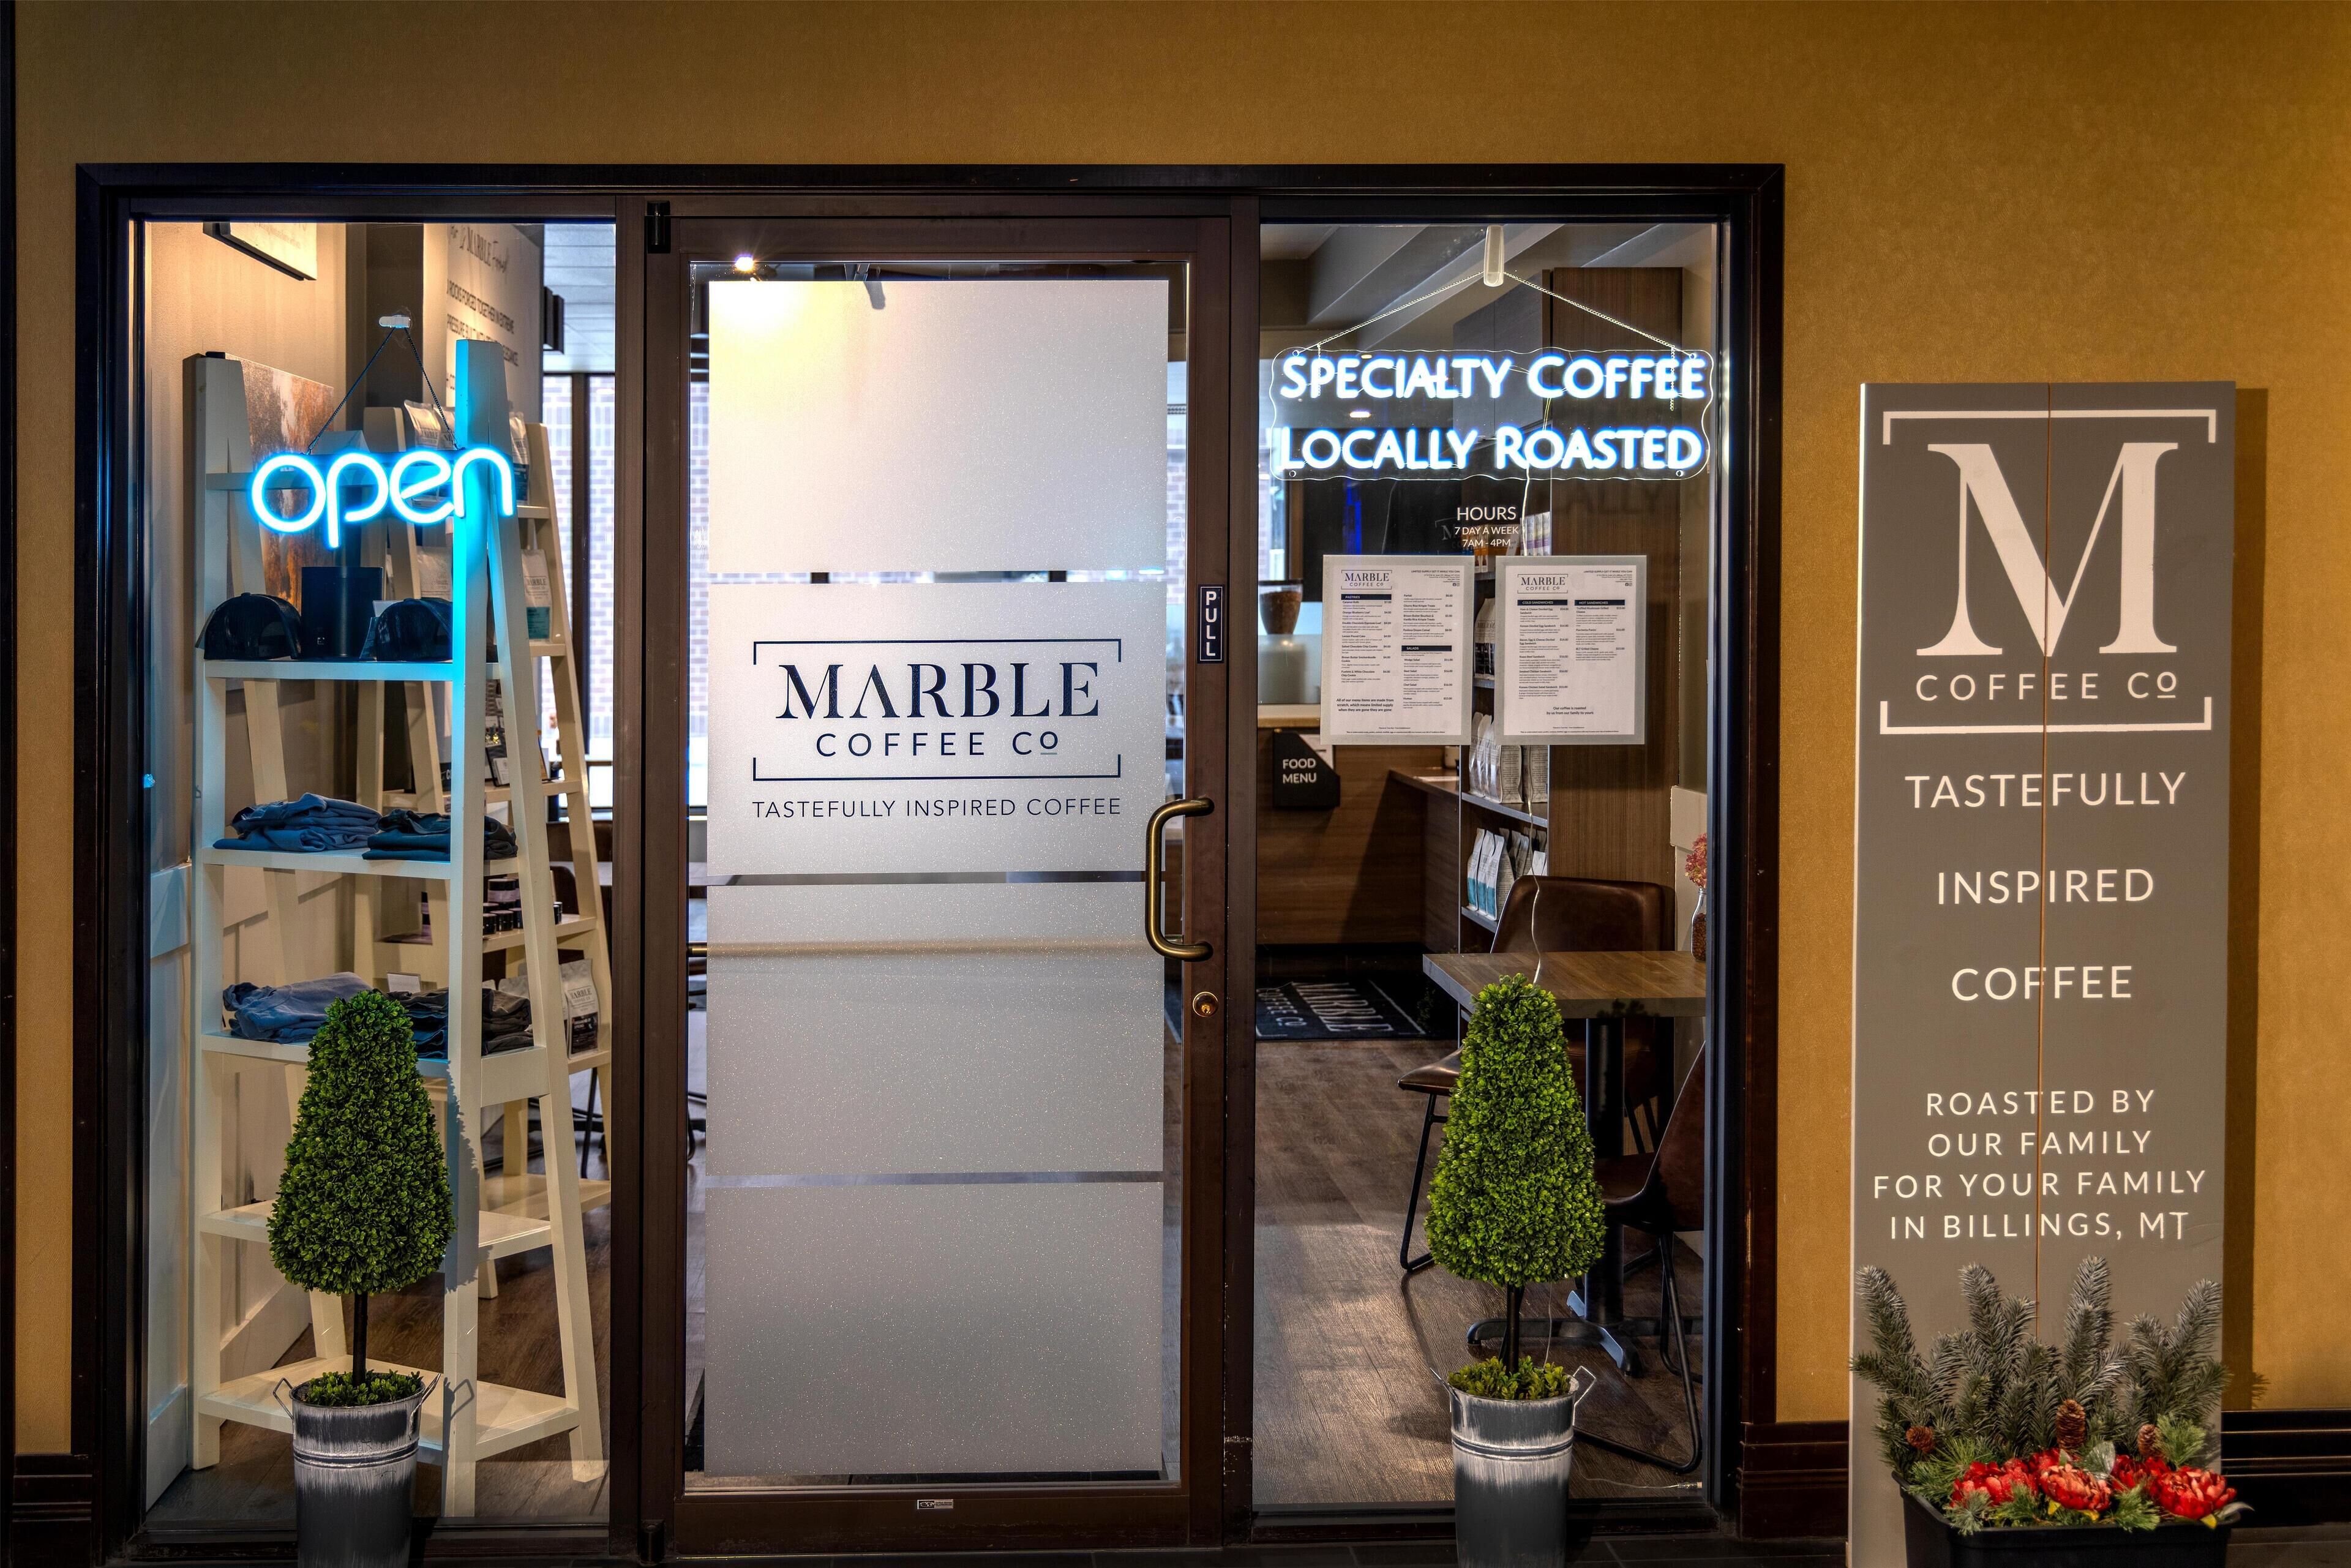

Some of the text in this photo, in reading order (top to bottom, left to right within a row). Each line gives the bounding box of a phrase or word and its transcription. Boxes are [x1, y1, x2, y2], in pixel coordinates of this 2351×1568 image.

[1280, 355, 1706, 399] SPECIALTY COFFEE
[1281, 426, 1704, 471] LOCALLY ROASTED
[252, 447, 514, 549] open
[1457, 507, 1517, 520] HOURS
[1491, 526, 1518, 535] WEEK
[1916, 442, 2178, 657] M
[1521, 577, 1565, 585] MARBLE
[1205, 591, 1217, 656] PULL
[776, 662, 1100, 719] MARBLE
[1916, 673, 2099, 701] COFFEE
[816, 732, 986, 757] COFFEE
[1283, 758, 1316, 769] FOOD
[1283, 773, 1316, 784] MENU
[1905, 772, 2186, 808] TASTEFULLY
[752, 798, 1120, 819] TASTEFULLY INSPIRED COFFEE
[1938, 869, 2154, 904] INSPIRED
[1952, 966, 2132, 1000] COFFEE
[1927, 1090, 2154, 1116] ROASTED BY
[1928, 1130, 2151, 1157] OUR FAMILY
[1873, 1170, 2205, 1199] FOR YOUR FAMILY
[1891, 1212, 2189, 1240] IN BILLINGS, MT
